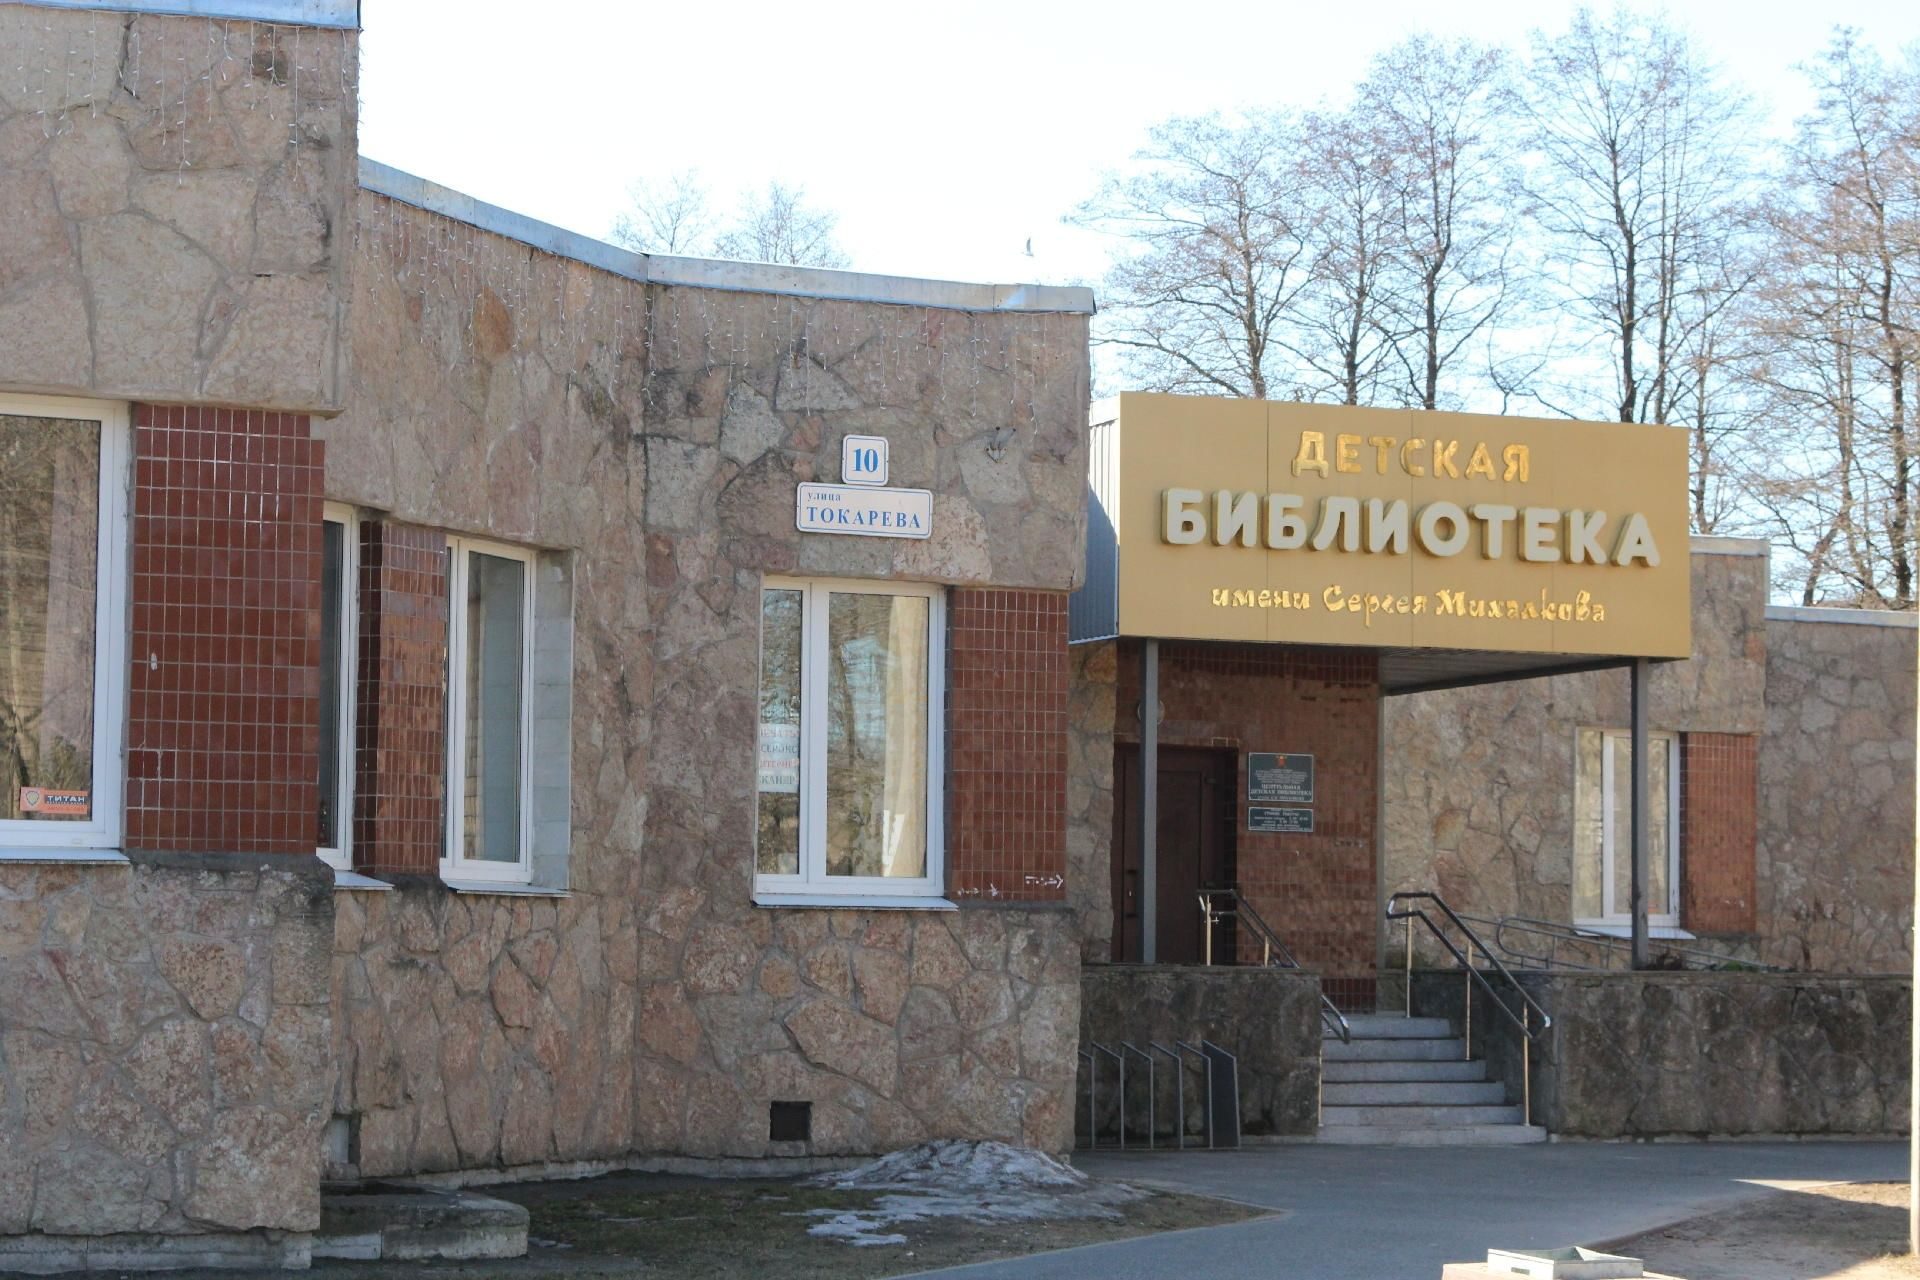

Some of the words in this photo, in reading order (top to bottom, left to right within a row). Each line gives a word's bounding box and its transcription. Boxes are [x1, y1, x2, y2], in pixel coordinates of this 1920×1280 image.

[853, 448, 879, 473] 10
[1291, 431, 1530, 482] ДЕТСКАЯ
[808, 492, 841, 502] улица
[806, 506, 921, 529] ТОКАРЕВА
[1161, 487, 1661, 567] БИБЛИОТЕКА
[1211, 588, 1311, 610] имени
[1323, 584, 1427, 628] Сергея
[1436, 588, 1606, 623] Михалкова
[760, 743, 798, 754] СЕРОКС
[760, 775, 796, 785] КАНЕР
